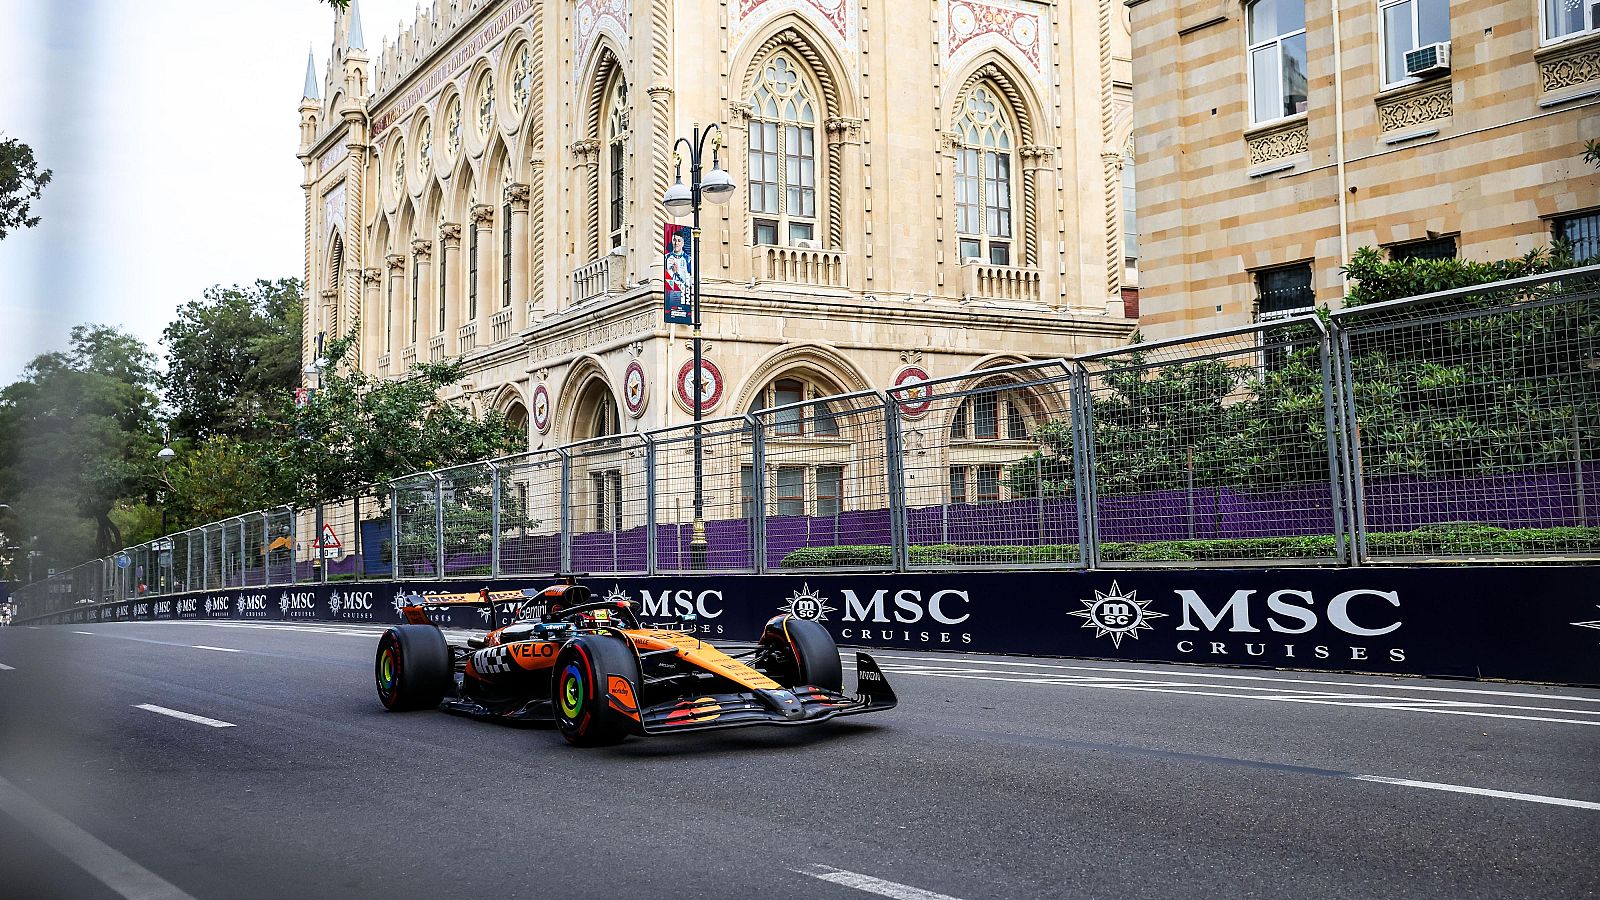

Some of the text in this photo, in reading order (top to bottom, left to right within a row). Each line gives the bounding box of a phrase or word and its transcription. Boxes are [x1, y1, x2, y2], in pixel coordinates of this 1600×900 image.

[158, 600, 171, 613] MSC
[182, 598, 197, 612] MSC
[212, 596, 229, 611] MSC
[246, 594, 267, 610] MSC
[290, 592, 315, 609] MSC
[343, 591, 373, 610] MSC
[639, 589, 723, 619] MSC
[840, 589, 970, 625] MSC
[137, 603, 148, 615] MSC
[518, 600, 548, 620] Gemini
[1174, 589, 1402, 637] MSC
[841, 628, 972, 643] CRUISES
[512, 643, 554, 657] VELO
[1177, 640, 1406, 662] CRUISES
[611, 687, 629, 696] workday
